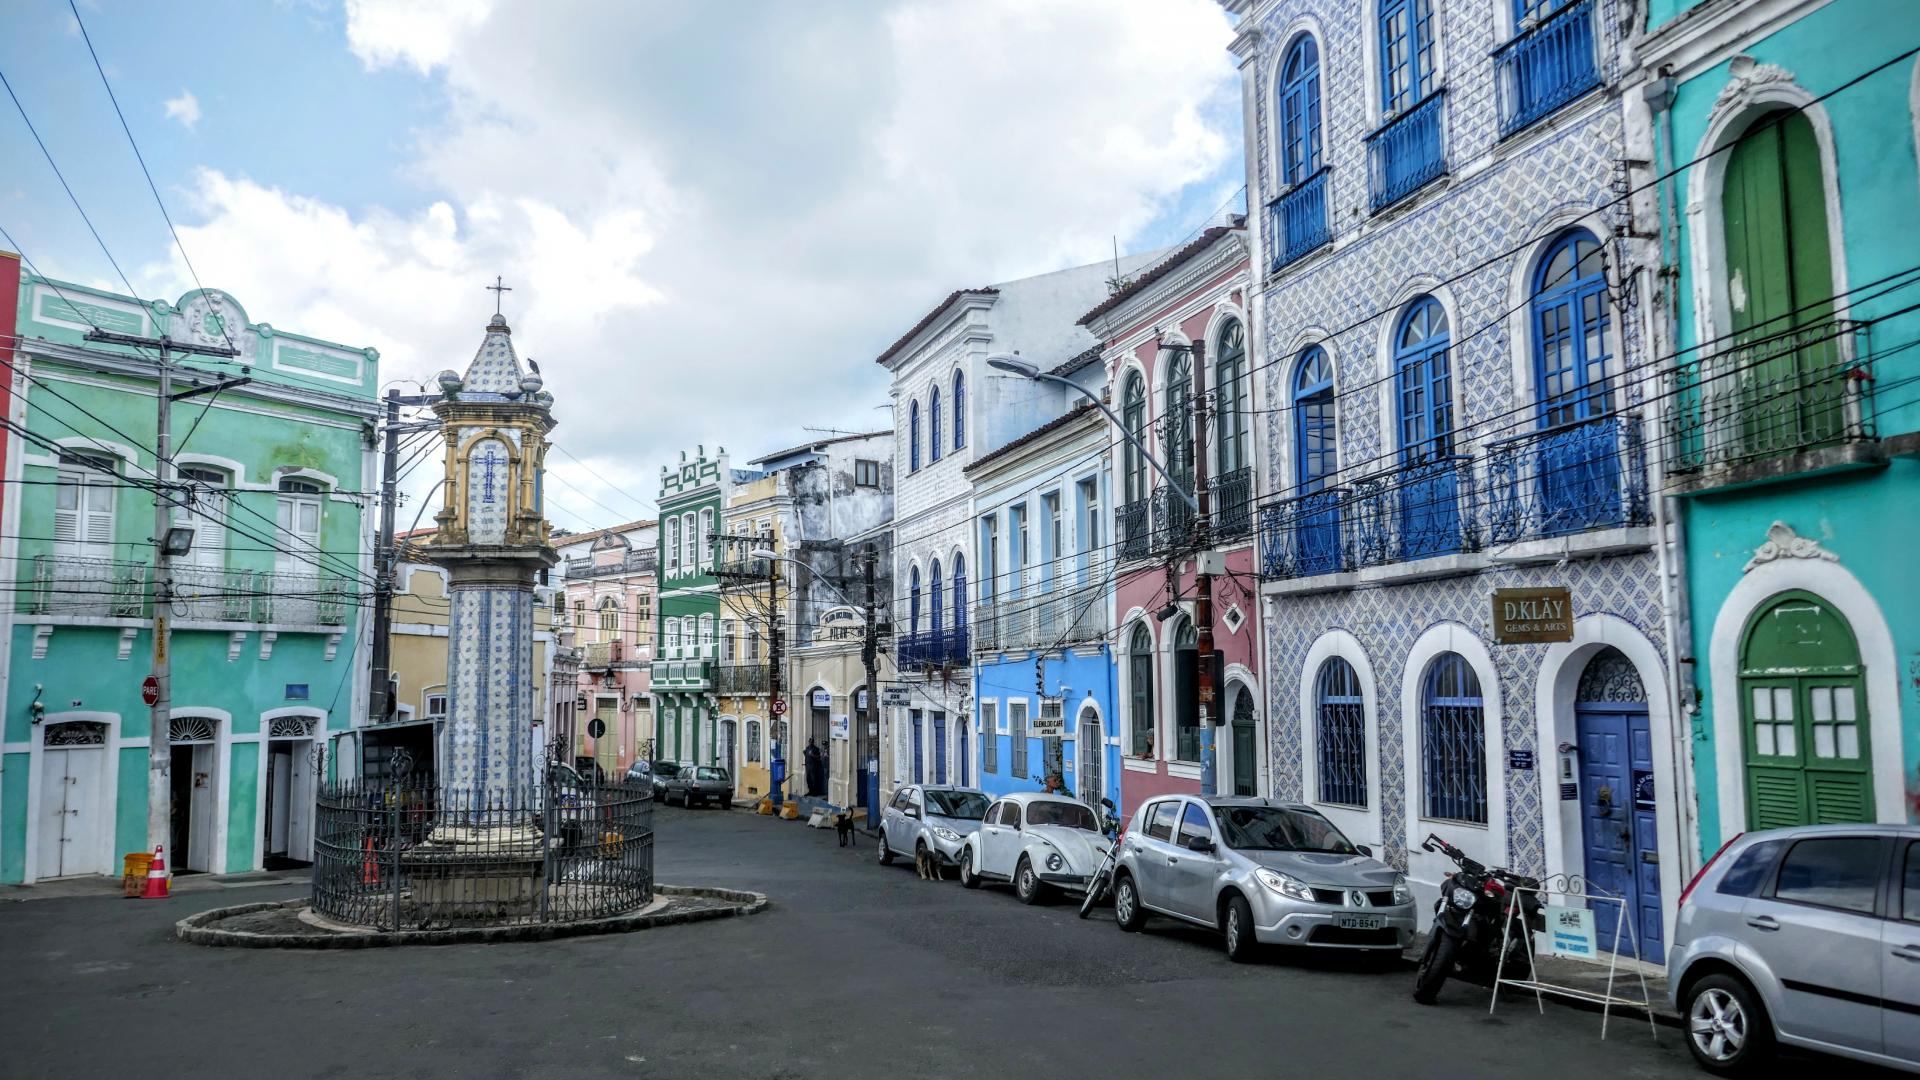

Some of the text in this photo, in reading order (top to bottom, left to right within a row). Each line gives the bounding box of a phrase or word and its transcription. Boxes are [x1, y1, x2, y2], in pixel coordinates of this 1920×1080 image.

[1504, 596, 1563, 621] D.KLÄY
[1505, 622, 1567, 633] GEMS & ARTS
[143, 686, 158, 696] PARE
